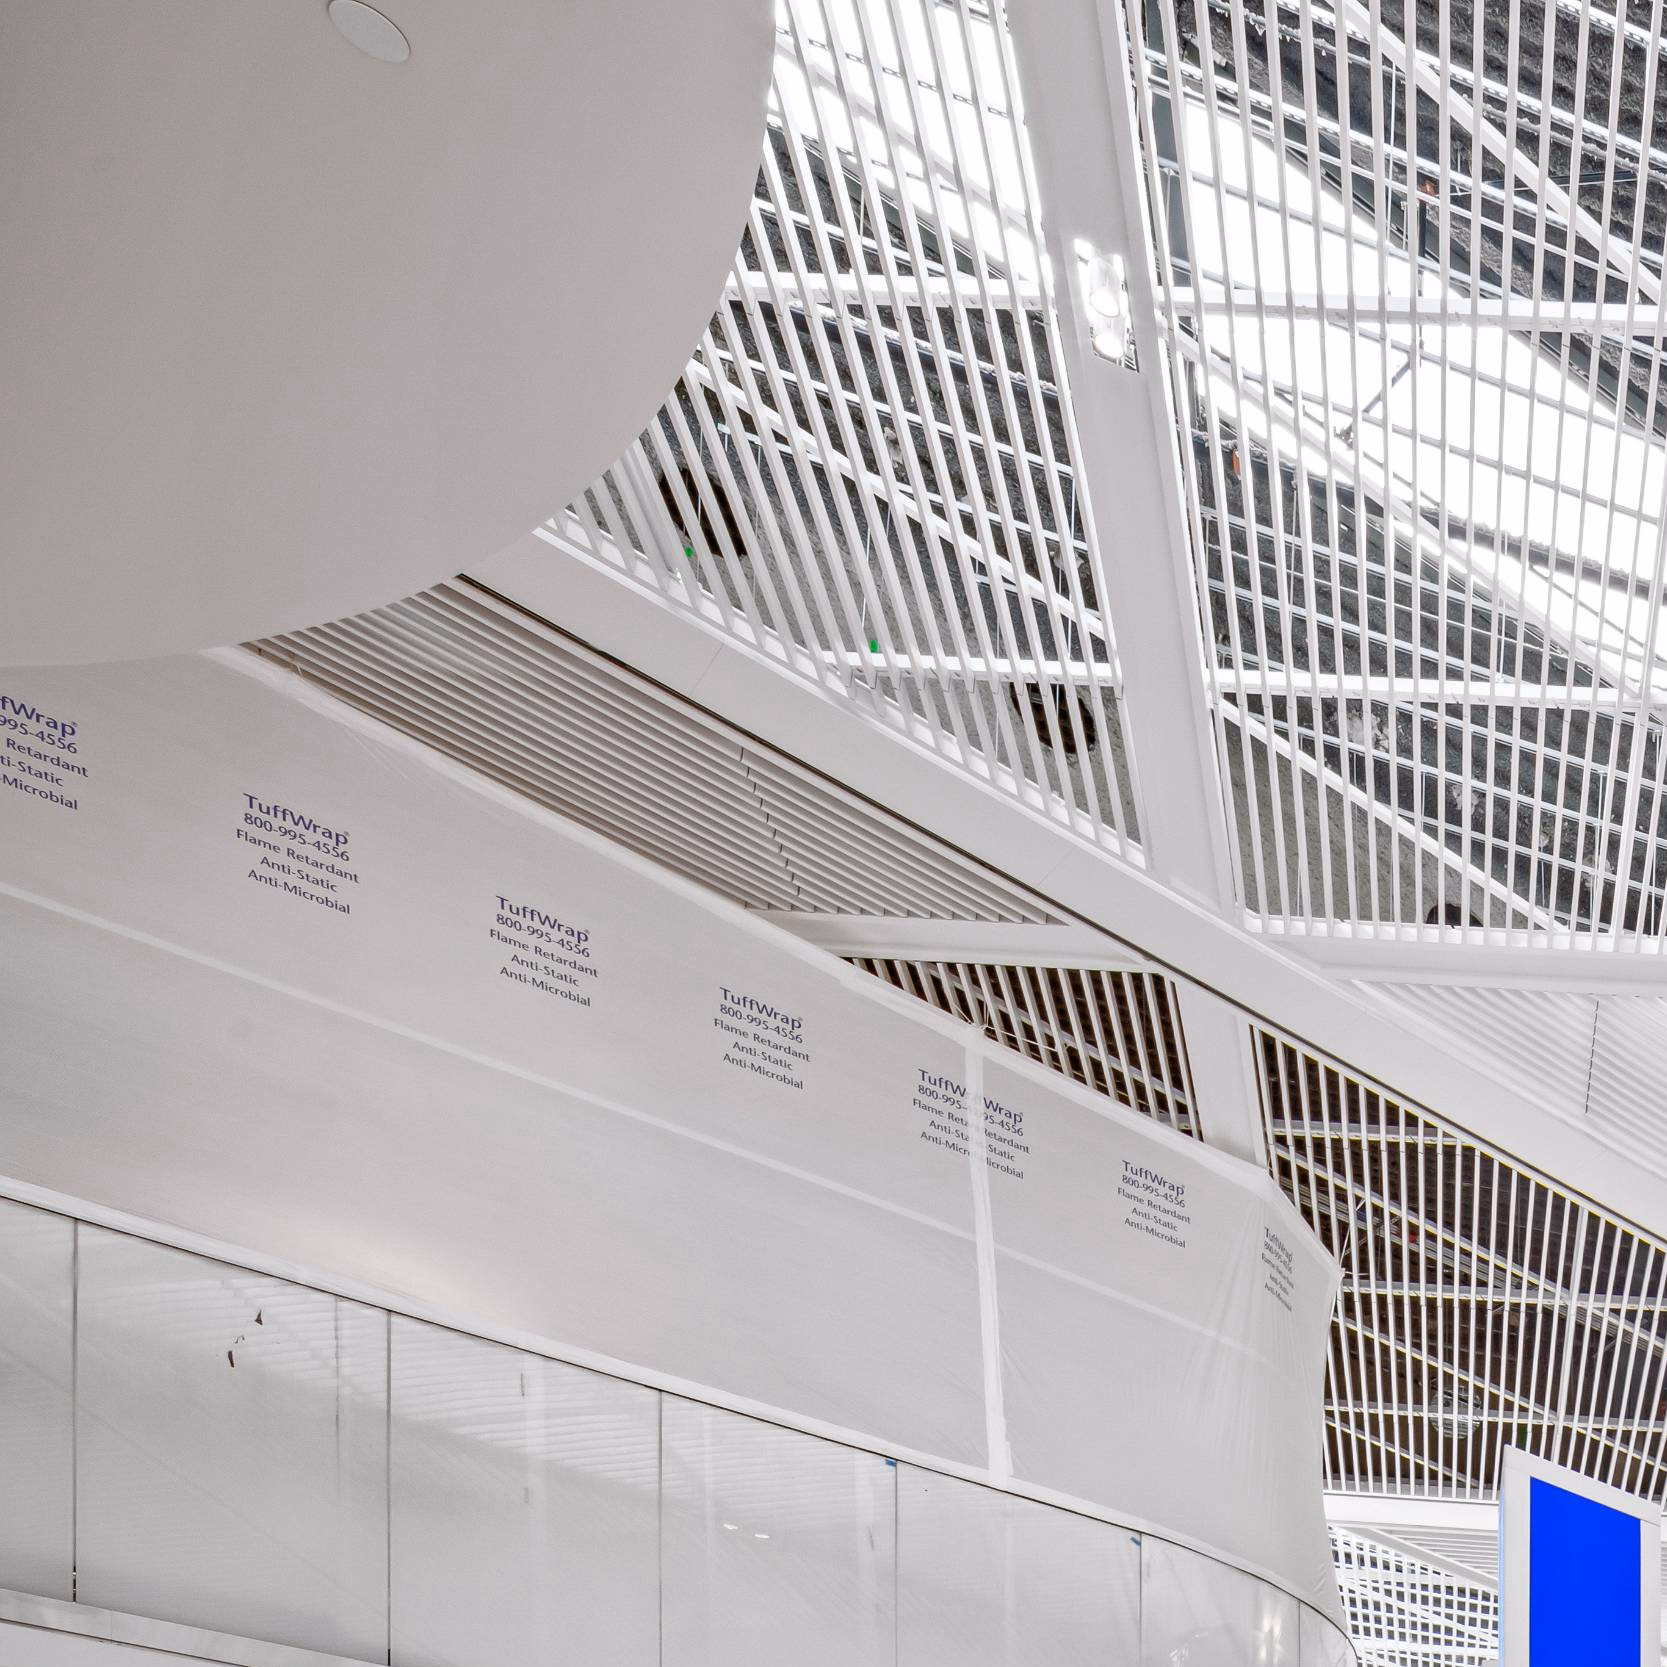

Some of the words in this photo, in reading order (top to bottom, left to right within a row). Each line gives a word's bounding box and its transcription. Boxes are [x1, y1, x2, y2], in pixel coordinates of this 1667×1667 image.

[6, 738, 89, 778] Retardant
[236, 828, 281, 854] Flame
[286, 847, 360, 884] Retardant
[244, 812, 350, 862] 800-995-4556
[247, 869, 351, 914] Anti-Microbial
[260, 856, 338, 893] Anti-Static
[490, 928, 530, 952] Flame
[534, 945, 599, 978] Retardant
[496, 913, 590, 958] 800-995-4556
[500, 966, 591, 1007] Anti-Microbial
[511, 954, 579, 987] Anti-Static
[714, 1018, 749, 1039] Flame
[753, 1032, 811, 1063] Retardant
[720, 1003, 803, 1044] 800-995-4556
[723, 1053, 804, 1090] Anti-Microbial
[732, 1041, 794, 1071] Anti-Static
[913, 1098, 944, 1118] Flame
[1117, 1187, 1145, 1205] Flame
[1147, 1200, 1191, 1225] Retardant
[1131, 1207, 1179, 1232] Anti-Static
[1124, 1217, 1186, 1249] Anti-Microbial
